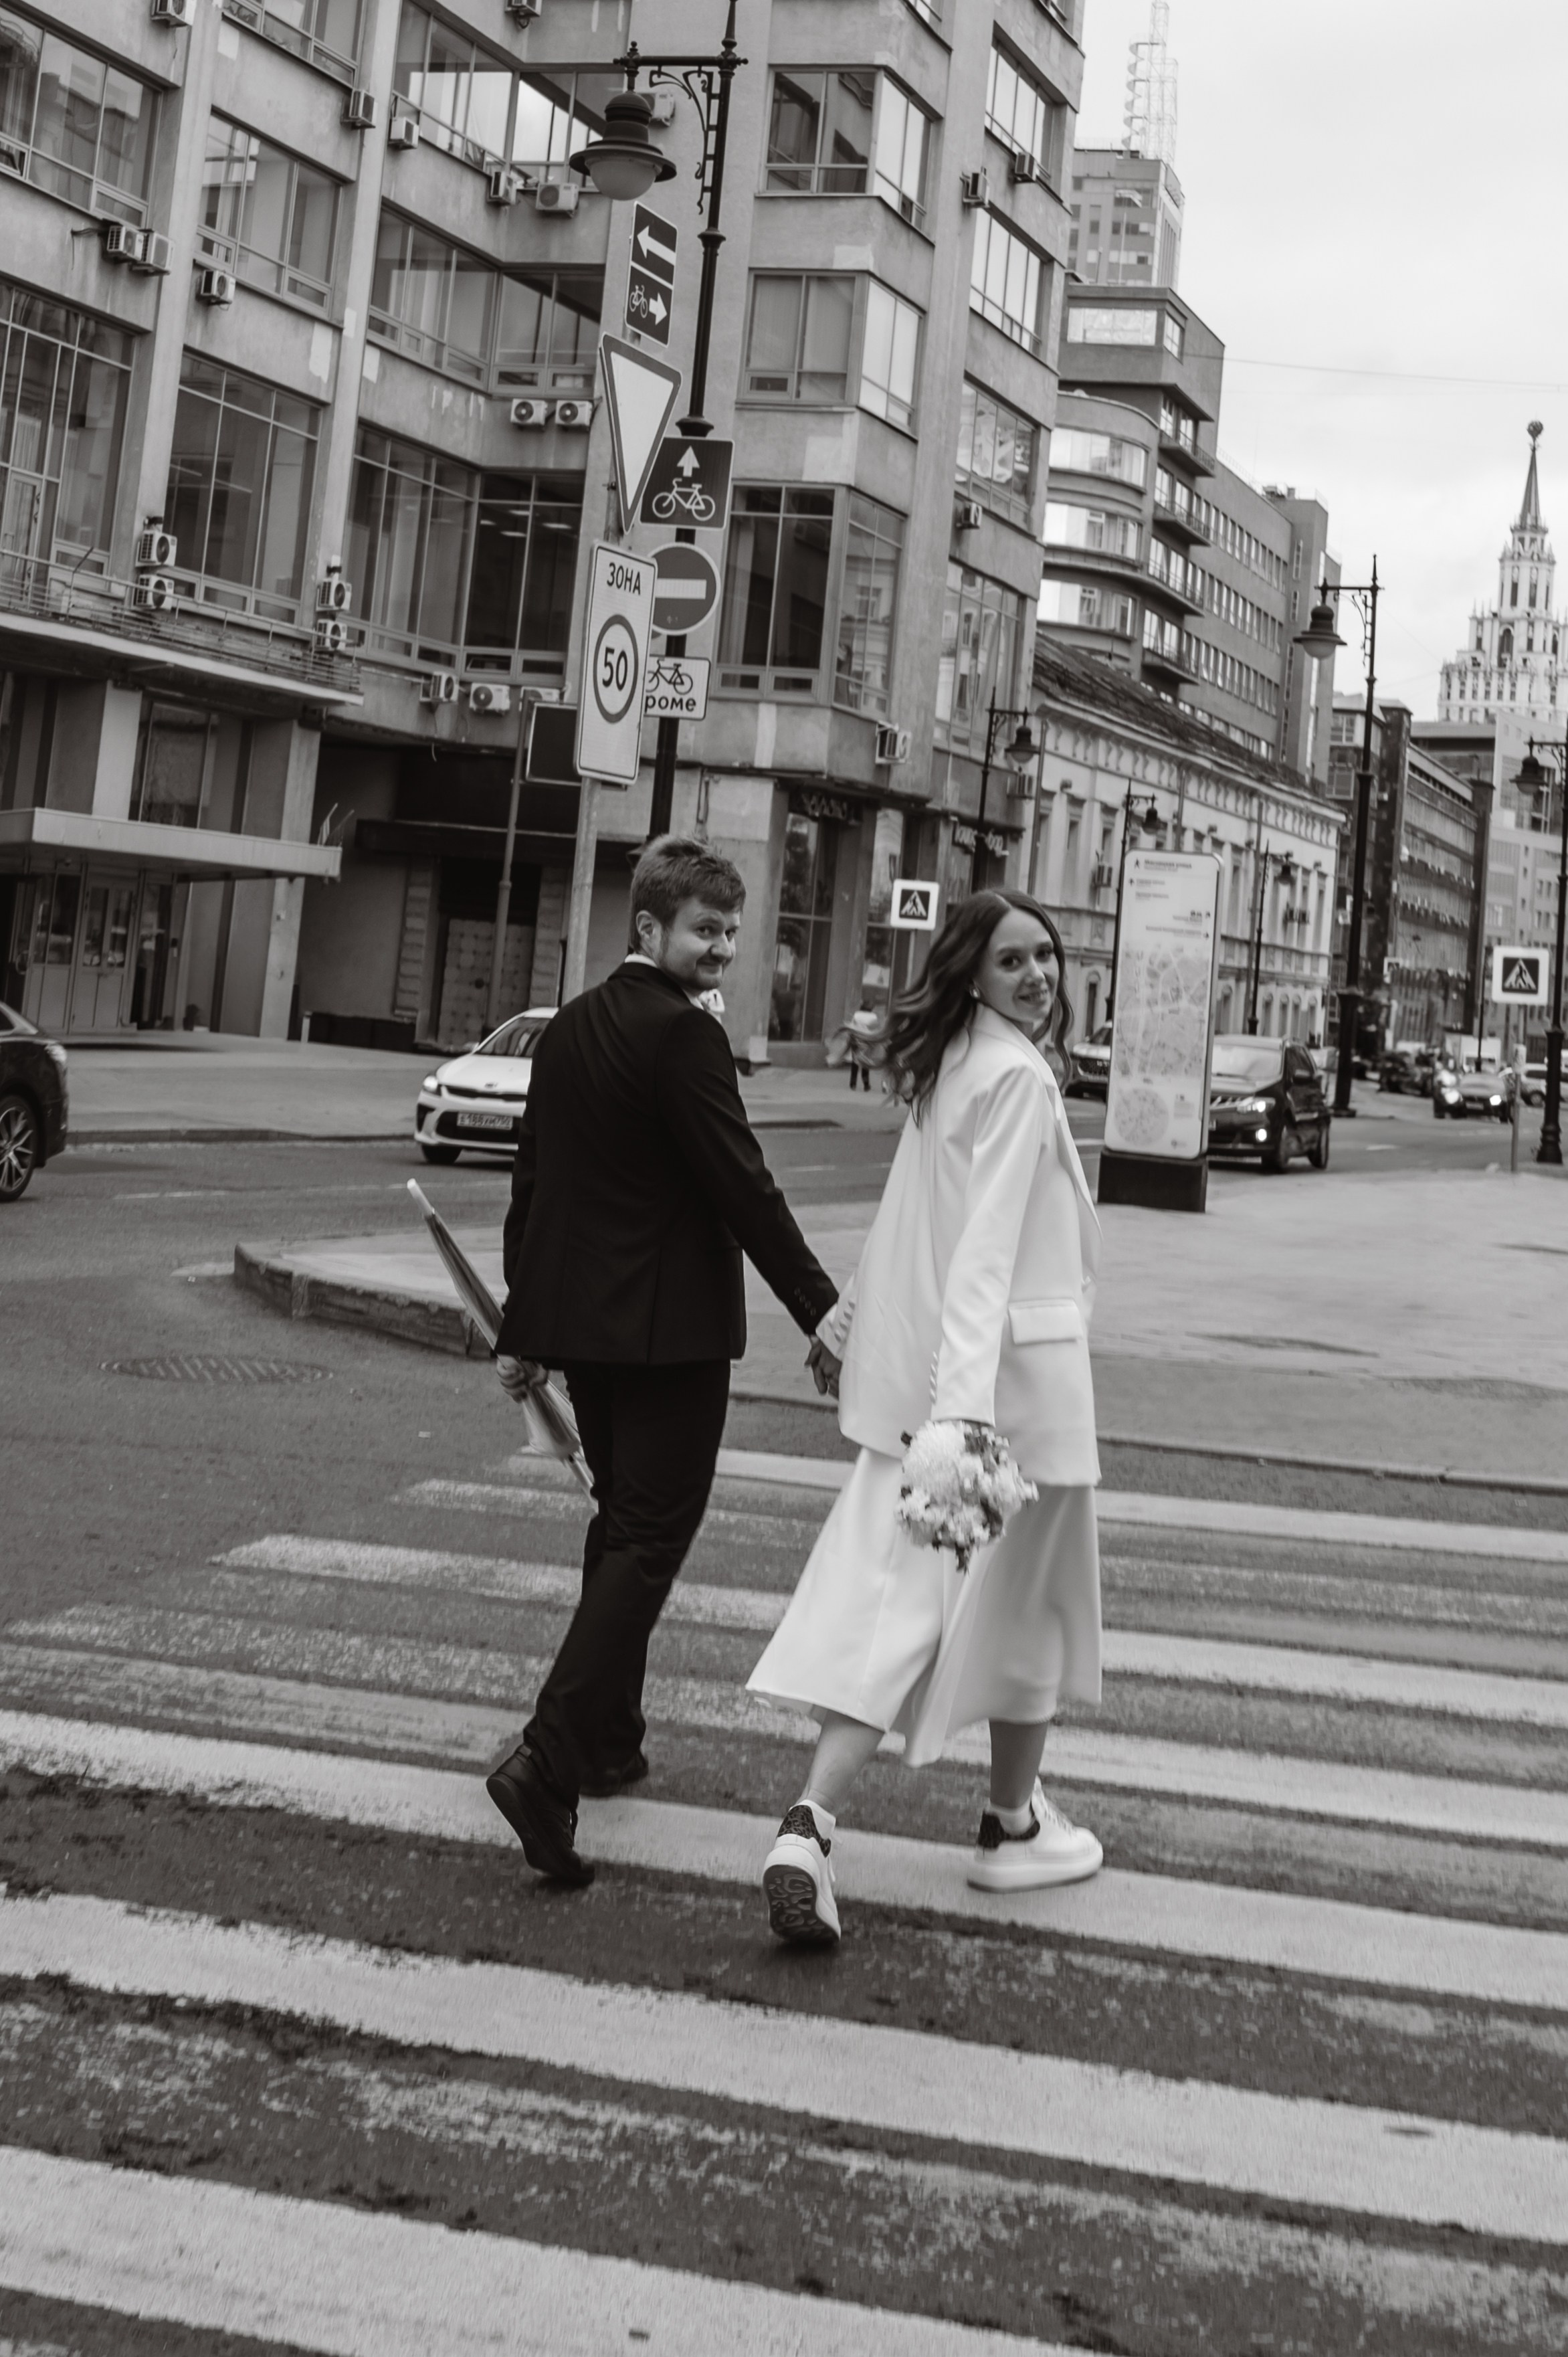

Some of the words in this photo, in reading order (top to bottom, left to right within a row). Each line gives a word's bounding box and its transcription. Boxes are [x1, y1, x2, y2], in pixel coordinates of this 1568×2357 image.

[607, 562, 641, 595] ЗОНА
[602, 646, 627, 691] 50
[644, 695, 696, 714] роме
